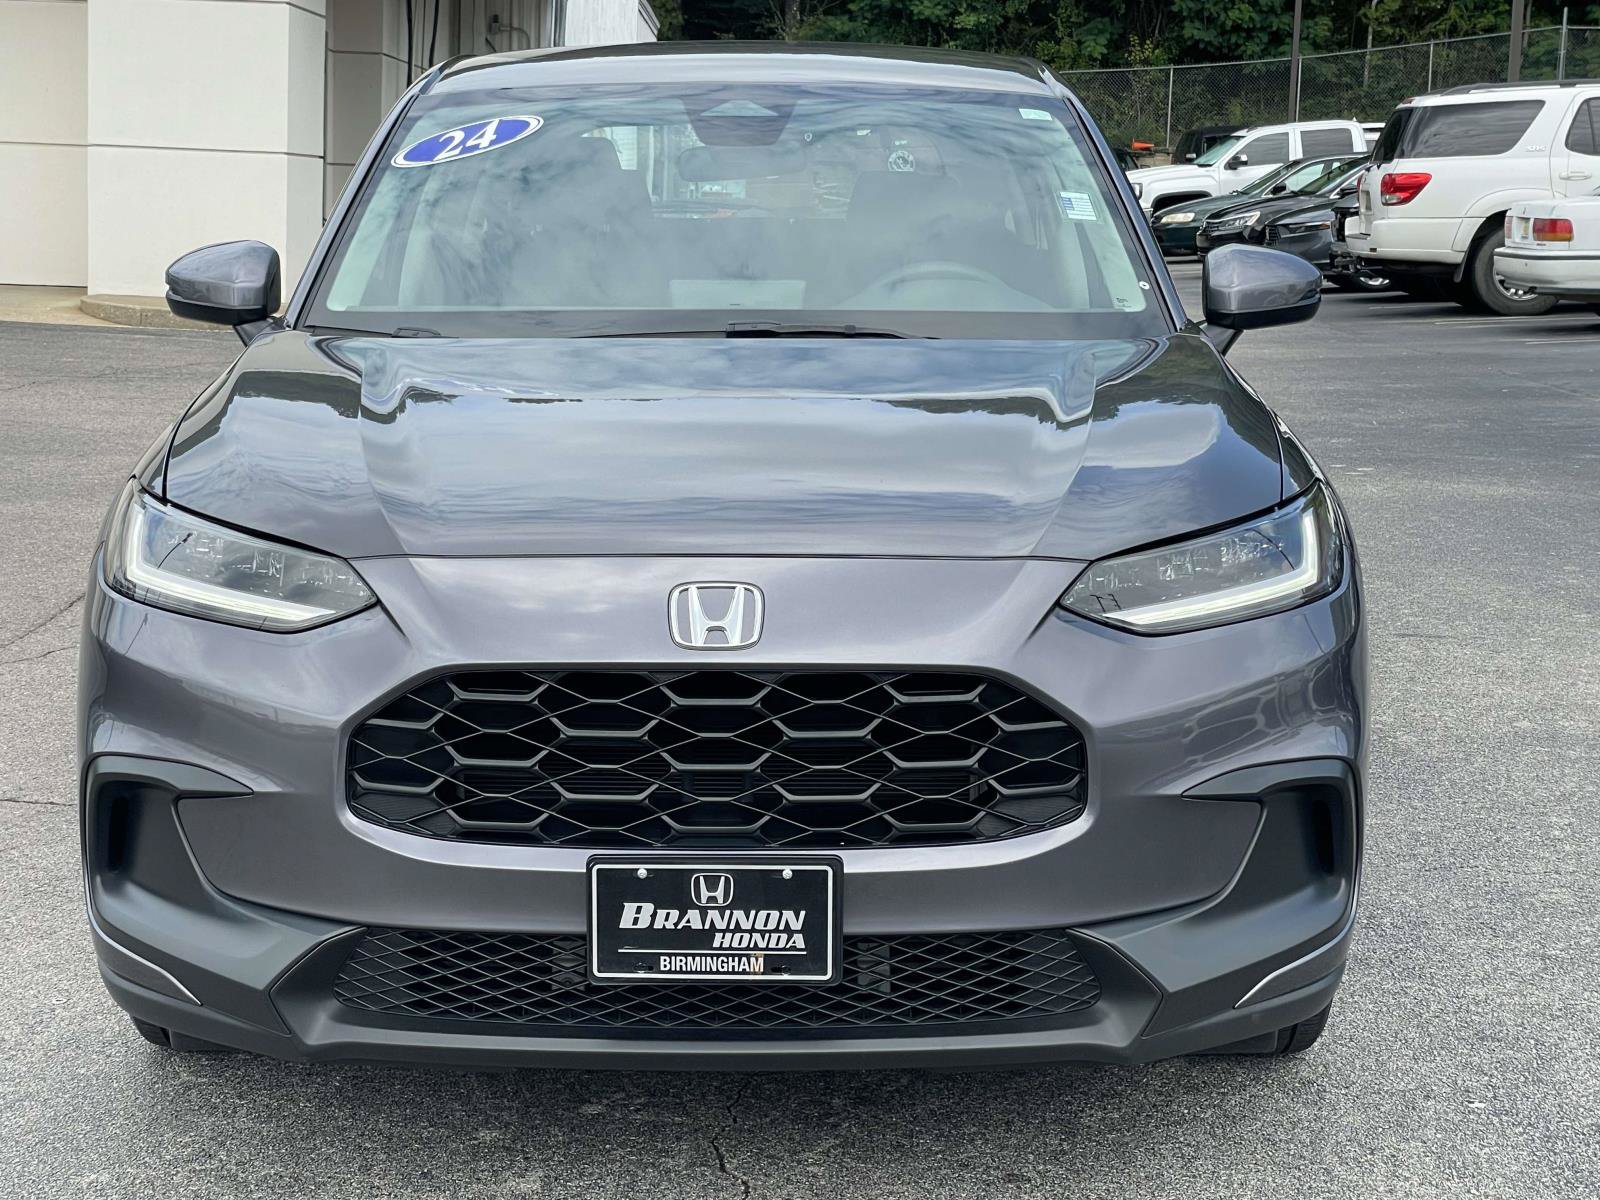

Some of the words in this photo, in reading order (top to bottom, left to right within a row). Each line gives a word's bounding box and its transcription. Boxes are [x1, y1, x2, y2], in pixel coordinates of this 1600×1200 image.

[433, 119, 500, 161] 24
[619, 902, 806, 930] BRANNON
[713, 932, 806, 949] HONDA
[660, 956, 764, 972] BIRMINGHAM
